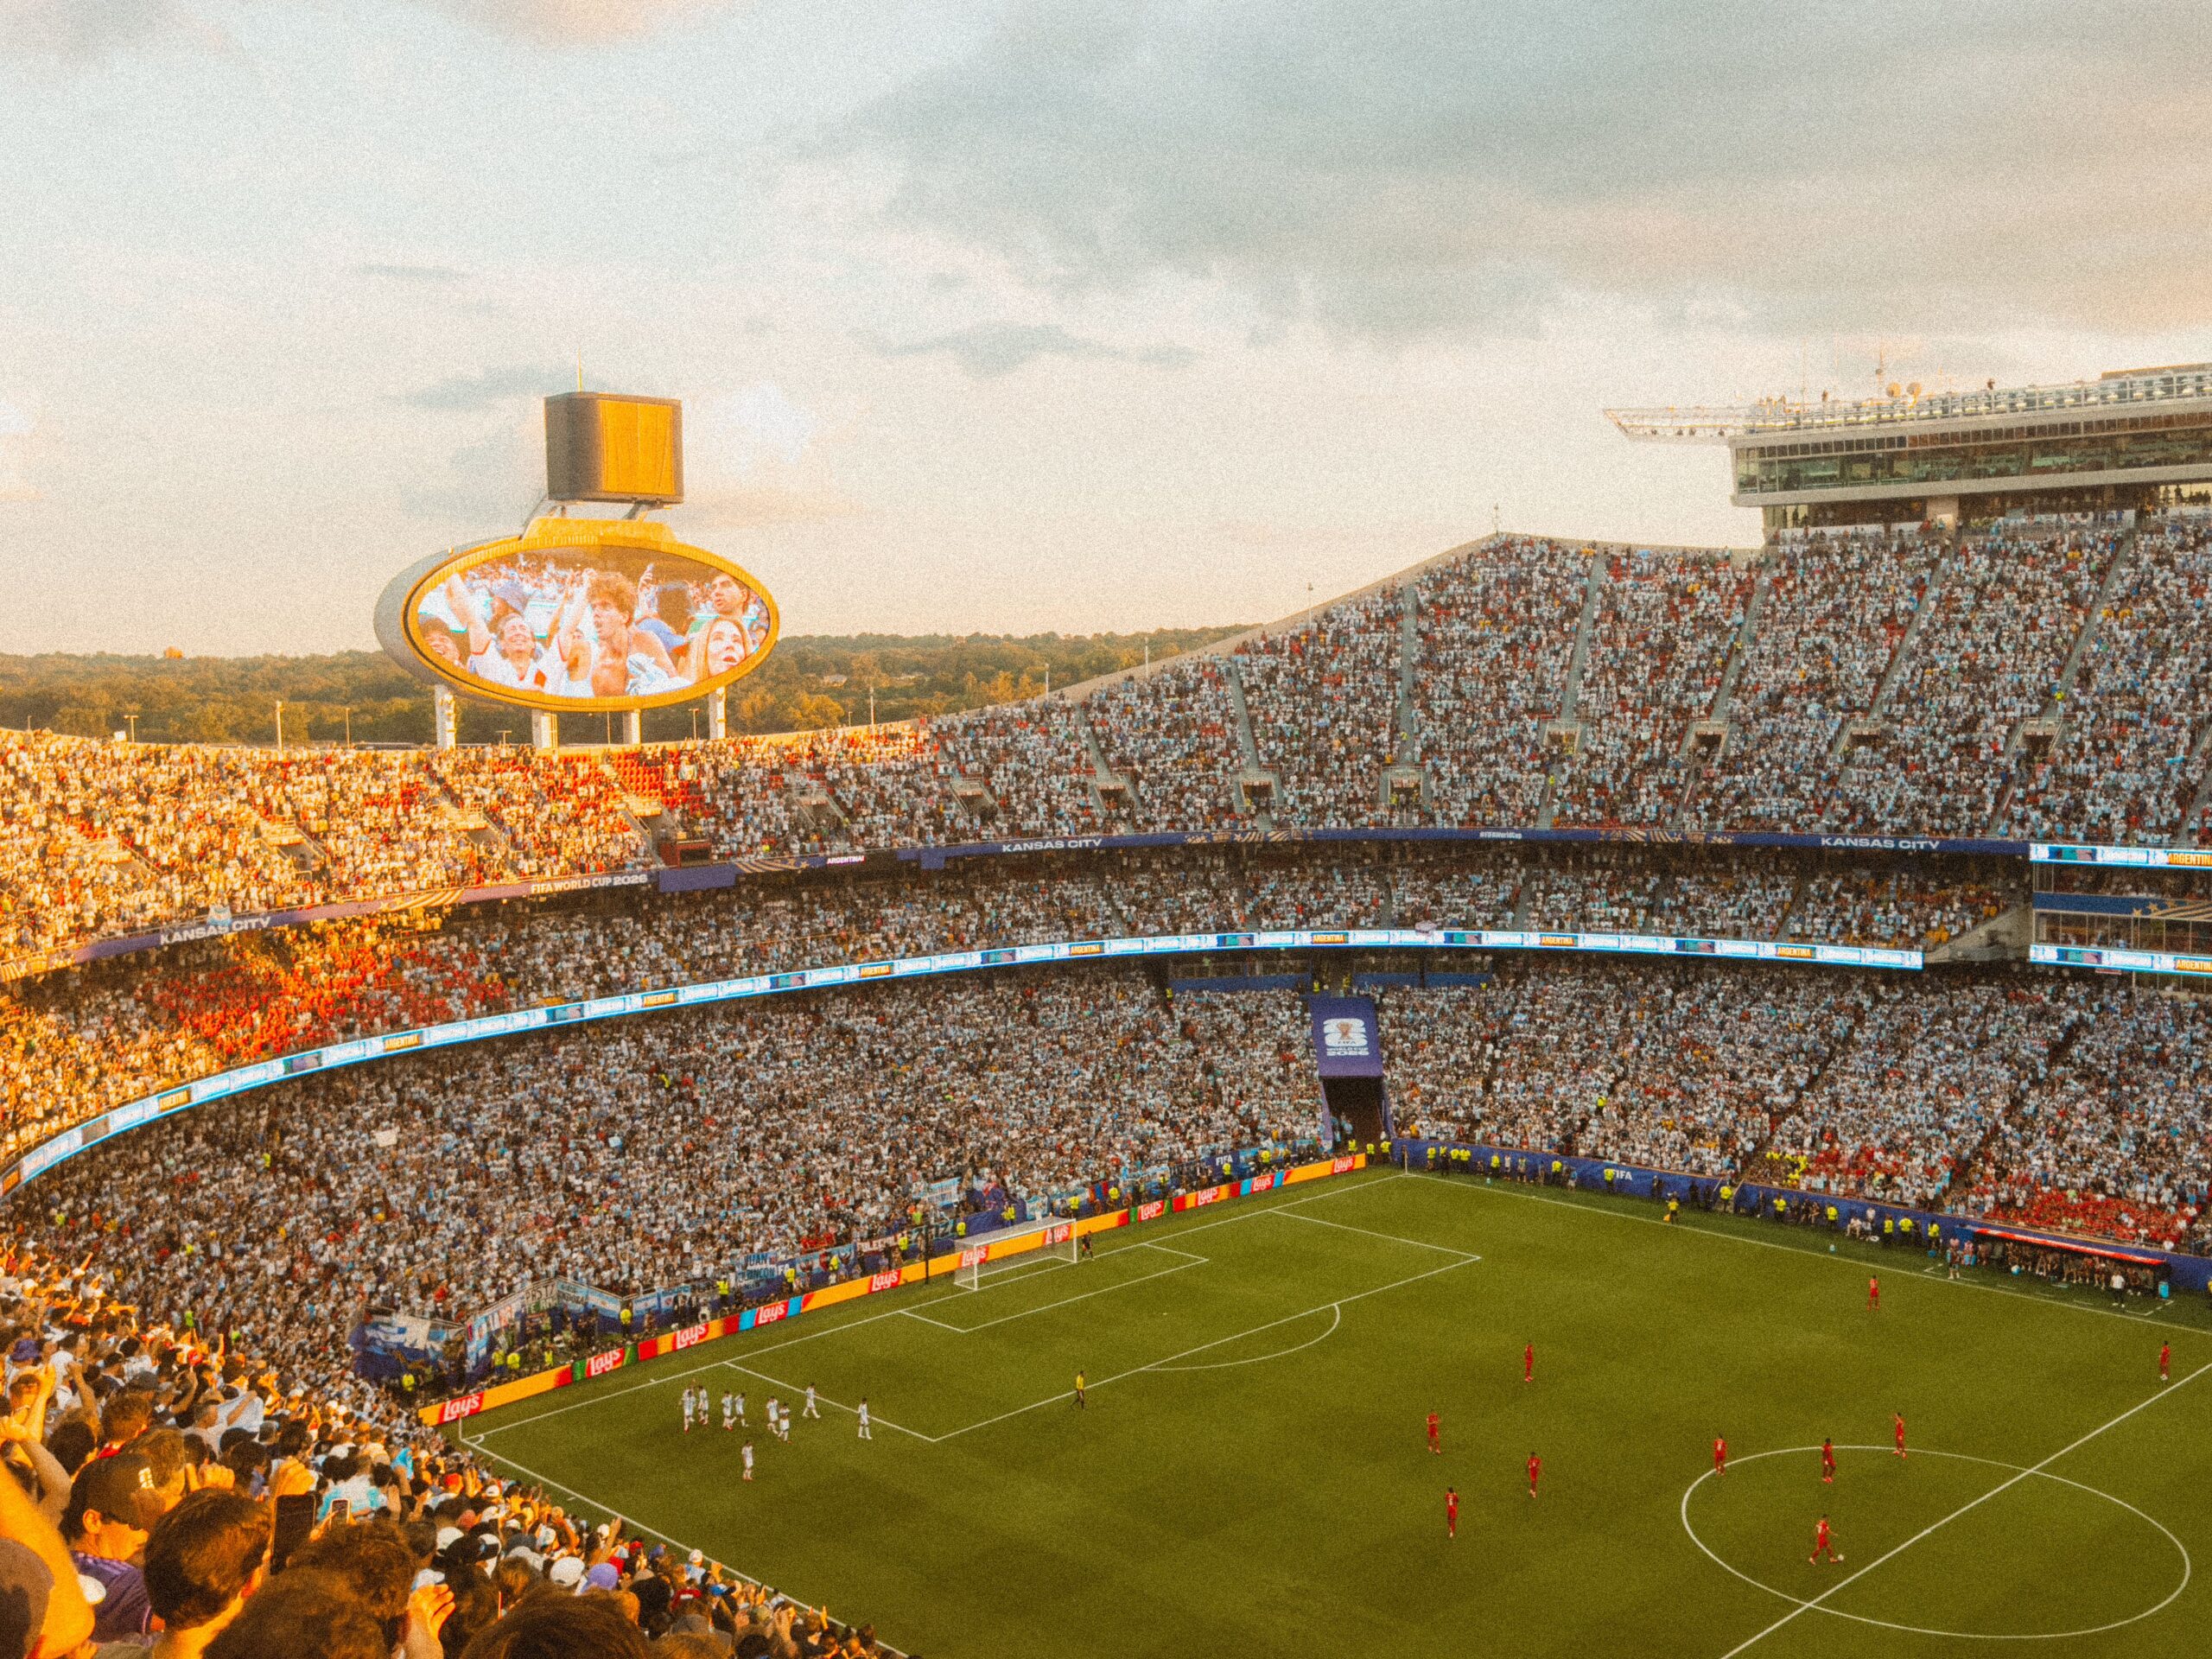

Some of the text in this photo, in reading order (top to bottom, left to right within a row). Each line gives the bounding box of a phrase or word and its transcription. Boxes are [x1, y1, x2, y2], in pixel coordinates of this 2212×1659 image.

[1002, 838, 1103, 852] KANSAS CITY
[1821, 837, 1940, 849] KANSAS CITY
[2168, 853, 2212, 865] ARGENTIN
[531, 874, 648, 894] FIFA WORLD CUP 2026
[160, 917, 271, 945] KANSAS CITY
[1216, 1154, 1233, 1166] FIFA
